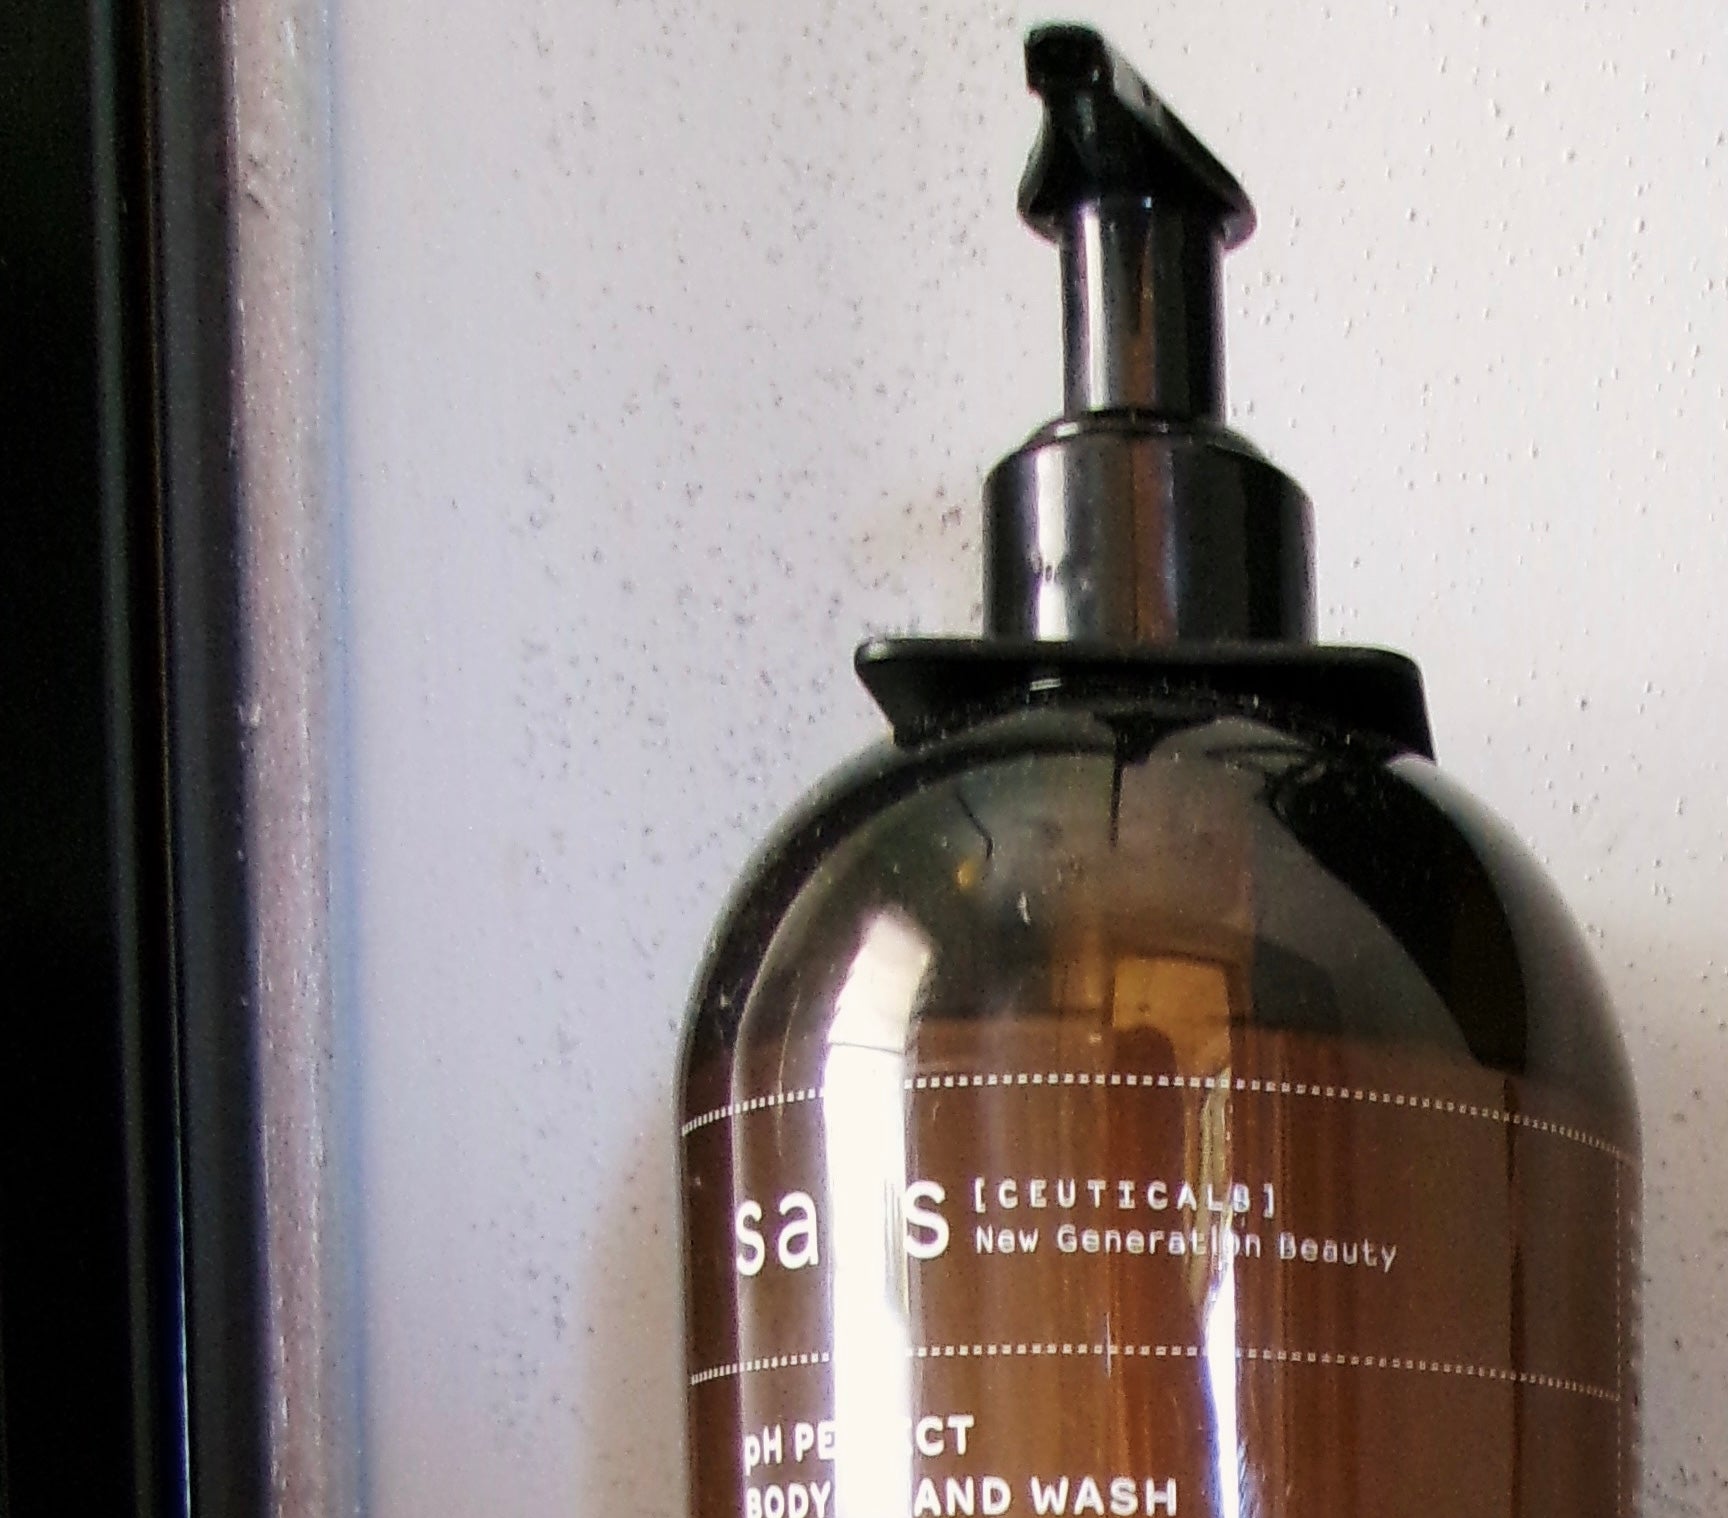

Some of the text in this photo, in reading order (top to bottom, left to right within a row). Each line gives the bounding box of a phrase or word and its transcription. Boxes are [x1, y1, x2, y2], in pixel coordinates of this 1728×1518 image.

[736, 1176, 1275, 1277] sas [CEUTICALS]
[974, 1223, 1398, 1273] New Generation Beauty
[743, 1414, 975, 1476] pH PECT
[906, 1475, 1012, 1518] AND
[1030, 1474, 1178, 1518] WASH
